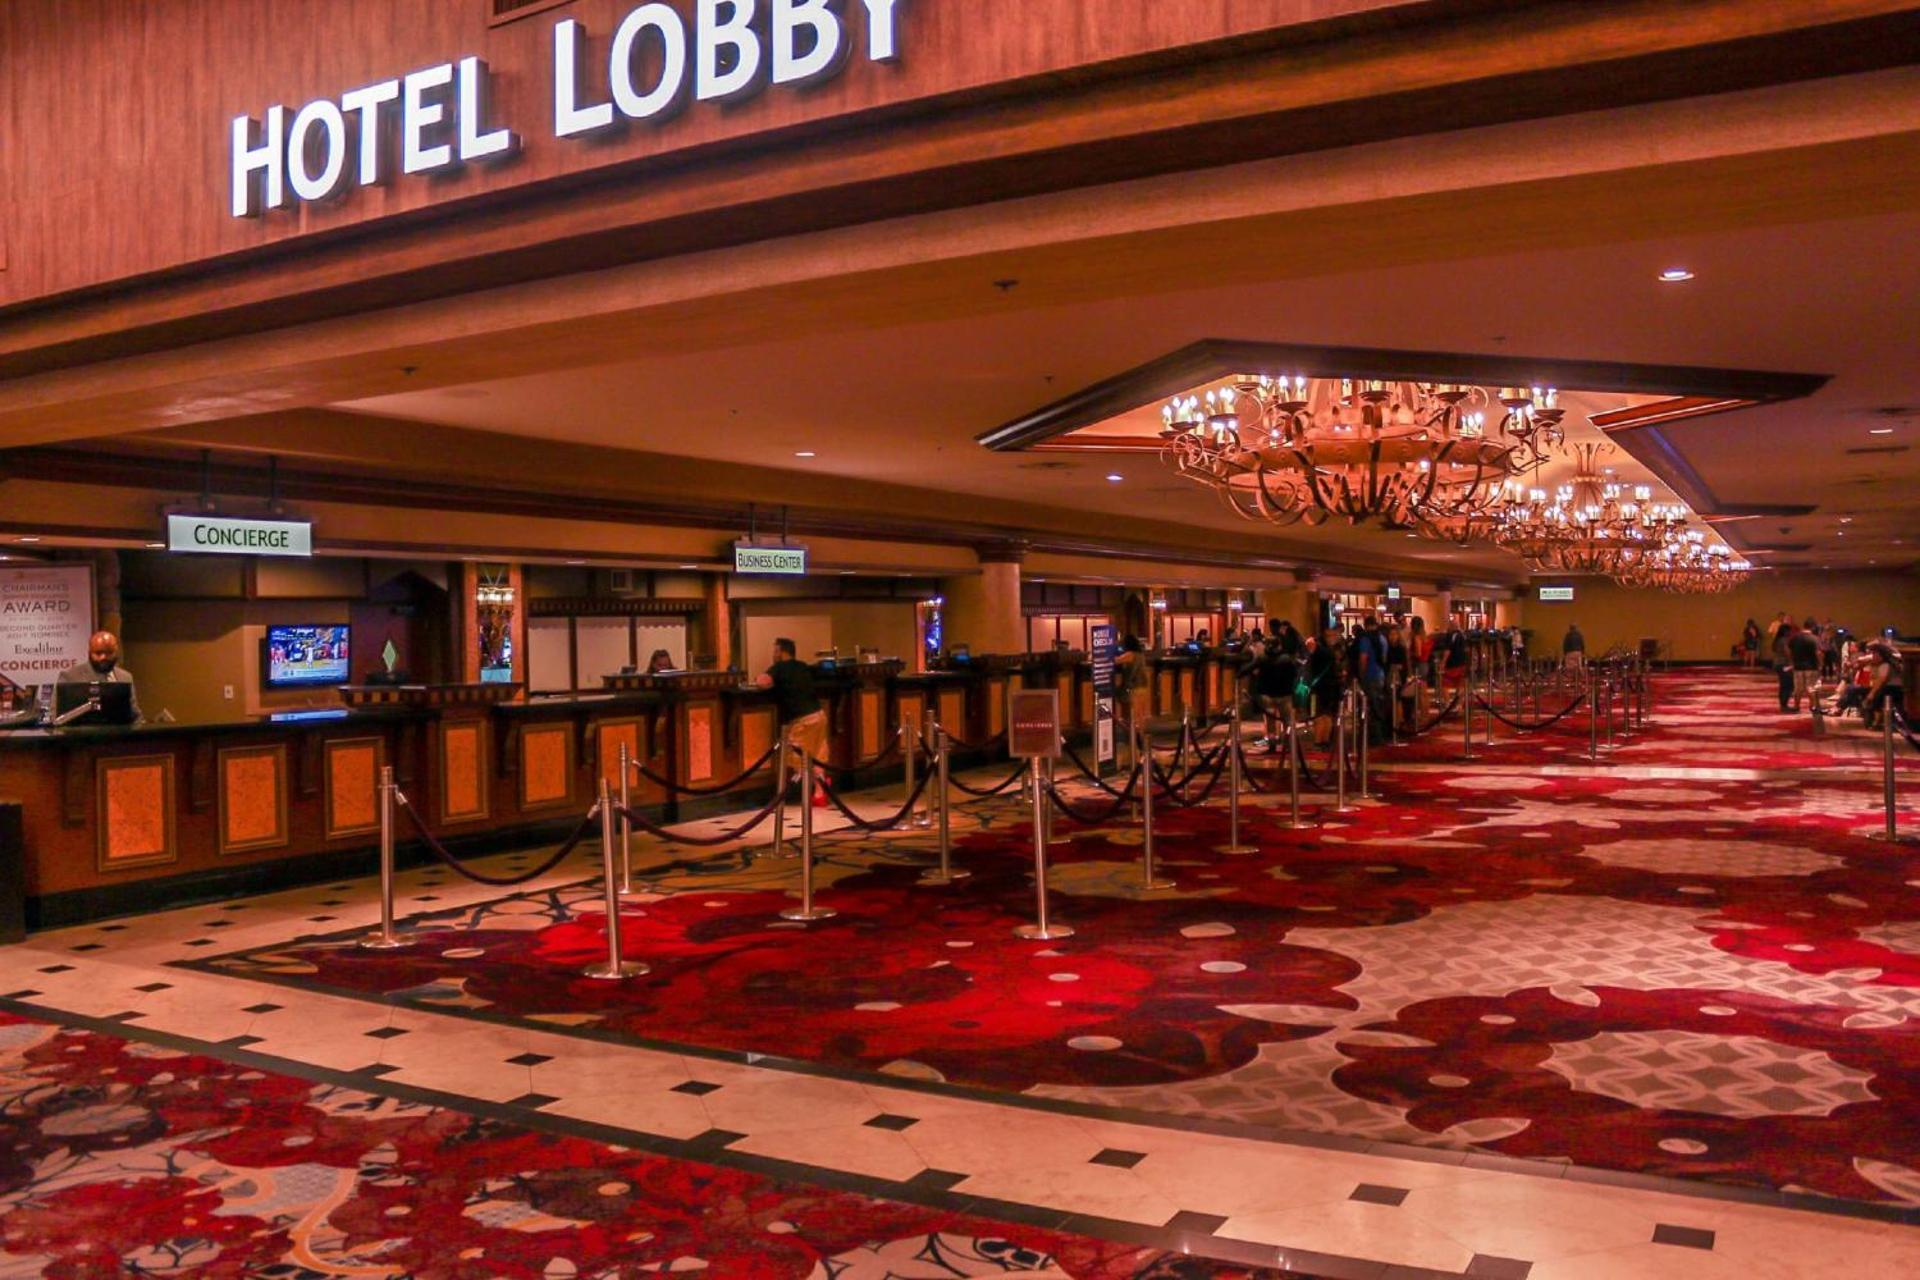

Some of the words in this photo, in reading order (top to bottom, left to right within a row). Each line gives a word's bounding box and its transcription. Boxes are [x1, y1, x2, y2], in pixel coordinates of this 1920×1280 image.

[231, 56, 512, 217] HOTEL
[194, 524, 289, 547] CONCIERGE
[738, 553, 772, 568] BUSINESS
[773, 554, 802, 568] CENTER
[3, 600, 71, 613] AWARD
